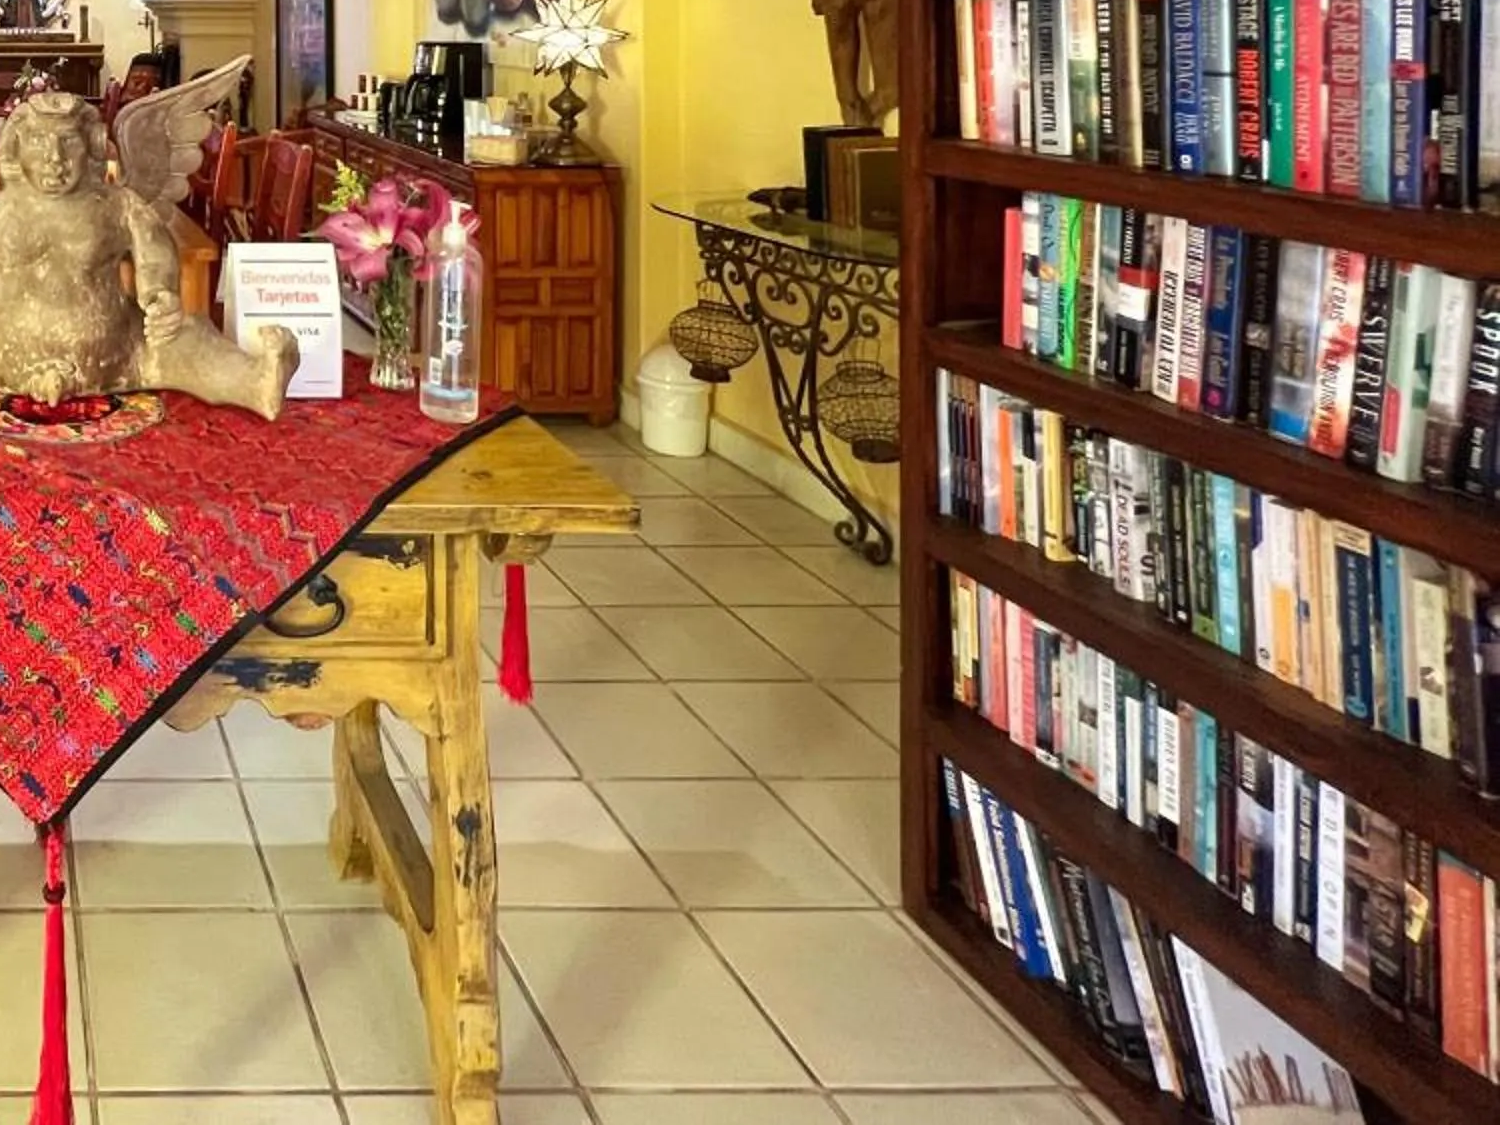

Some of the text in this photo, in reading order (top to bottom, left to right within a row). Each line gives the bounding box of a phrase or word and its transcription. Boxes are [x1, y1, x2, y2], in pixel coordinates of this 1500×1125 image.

[1331, 19, 1359, 52] ARE
[1395, 7, 1414, 26] LEE
[1173, 29, 1197, 104] BALDACCI
[1238, 47, 1259, 107] ROBERT
[1331, 53, 1359, 84] RED
[1041, 80, 1058, 133] SCARPETTA
[1296, 73, 1312, 162] ATONEMENT
[1238, 111, 1260, 159] CRAIS
[1331, 96, 1360, 187] PATTERSON
[257, 288, 320, 306] Tarjetas
[296, 327, 320, 336] VISA
[1469, 307, 1500, 395] SPOOK
[1352, 314, 1389, 425] SWERVE
[1116, 495, 1132, 584] DEAD SOULS
